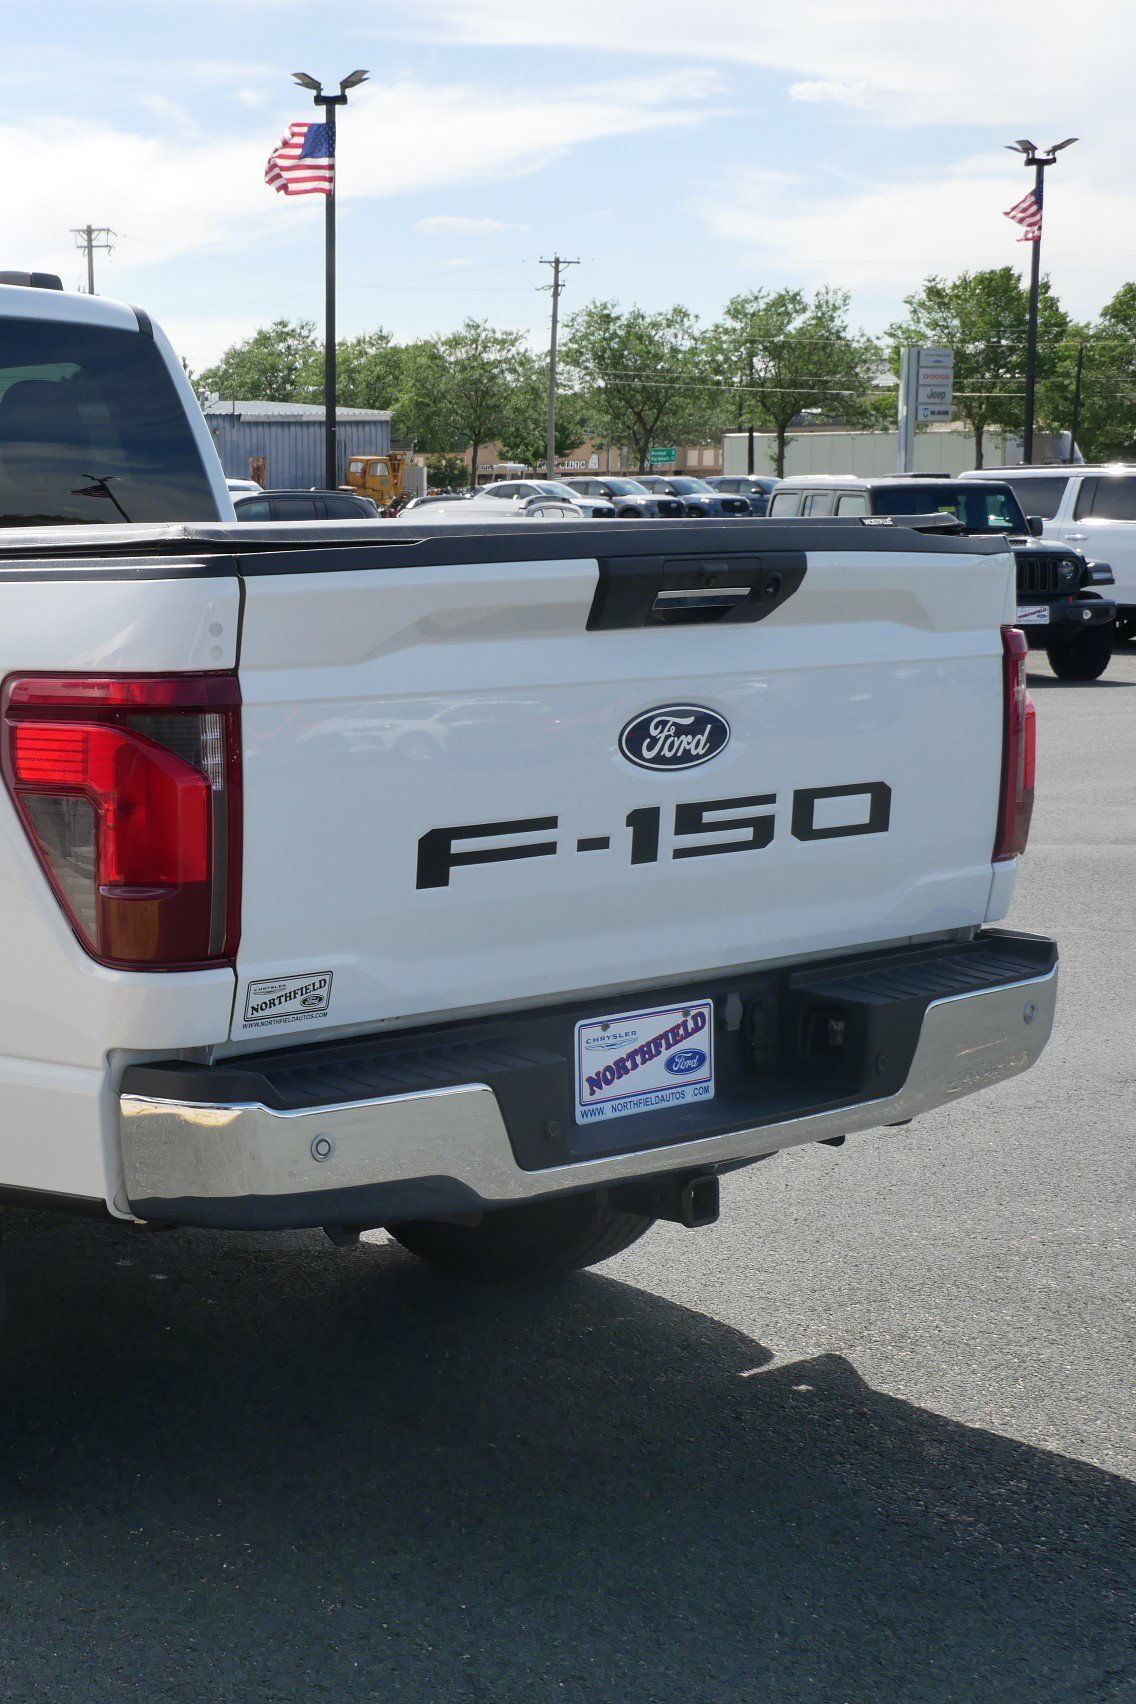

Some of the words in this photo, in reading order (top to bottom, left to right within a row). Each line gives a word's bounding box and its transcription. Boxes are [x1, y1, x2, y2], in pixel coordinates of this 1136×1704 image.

[927, 388, 946, 400] Jeep
[641, 715, 711, 760] Ford
[415, 780, 892, 890] F-150
[250, 978, 327, 1016] NORTHFIELD
[253, 984, 286, 992] CHRYSLER
[242, 1011, 328, 1029] WWW.NORTHFIELDAUTOS.COM
[585, 1030, 637, 1045] CHRYSLER
[585, 1010, 707, 1097] NORTHFIELD
[672, 1051, 699, 1071] Ford
[580, 1106, 606, 1119] WWW.
[611, 1090, 686, 1114] NORTHFIELDAUTOS
[691, 1085, 710, 1098] .COM
